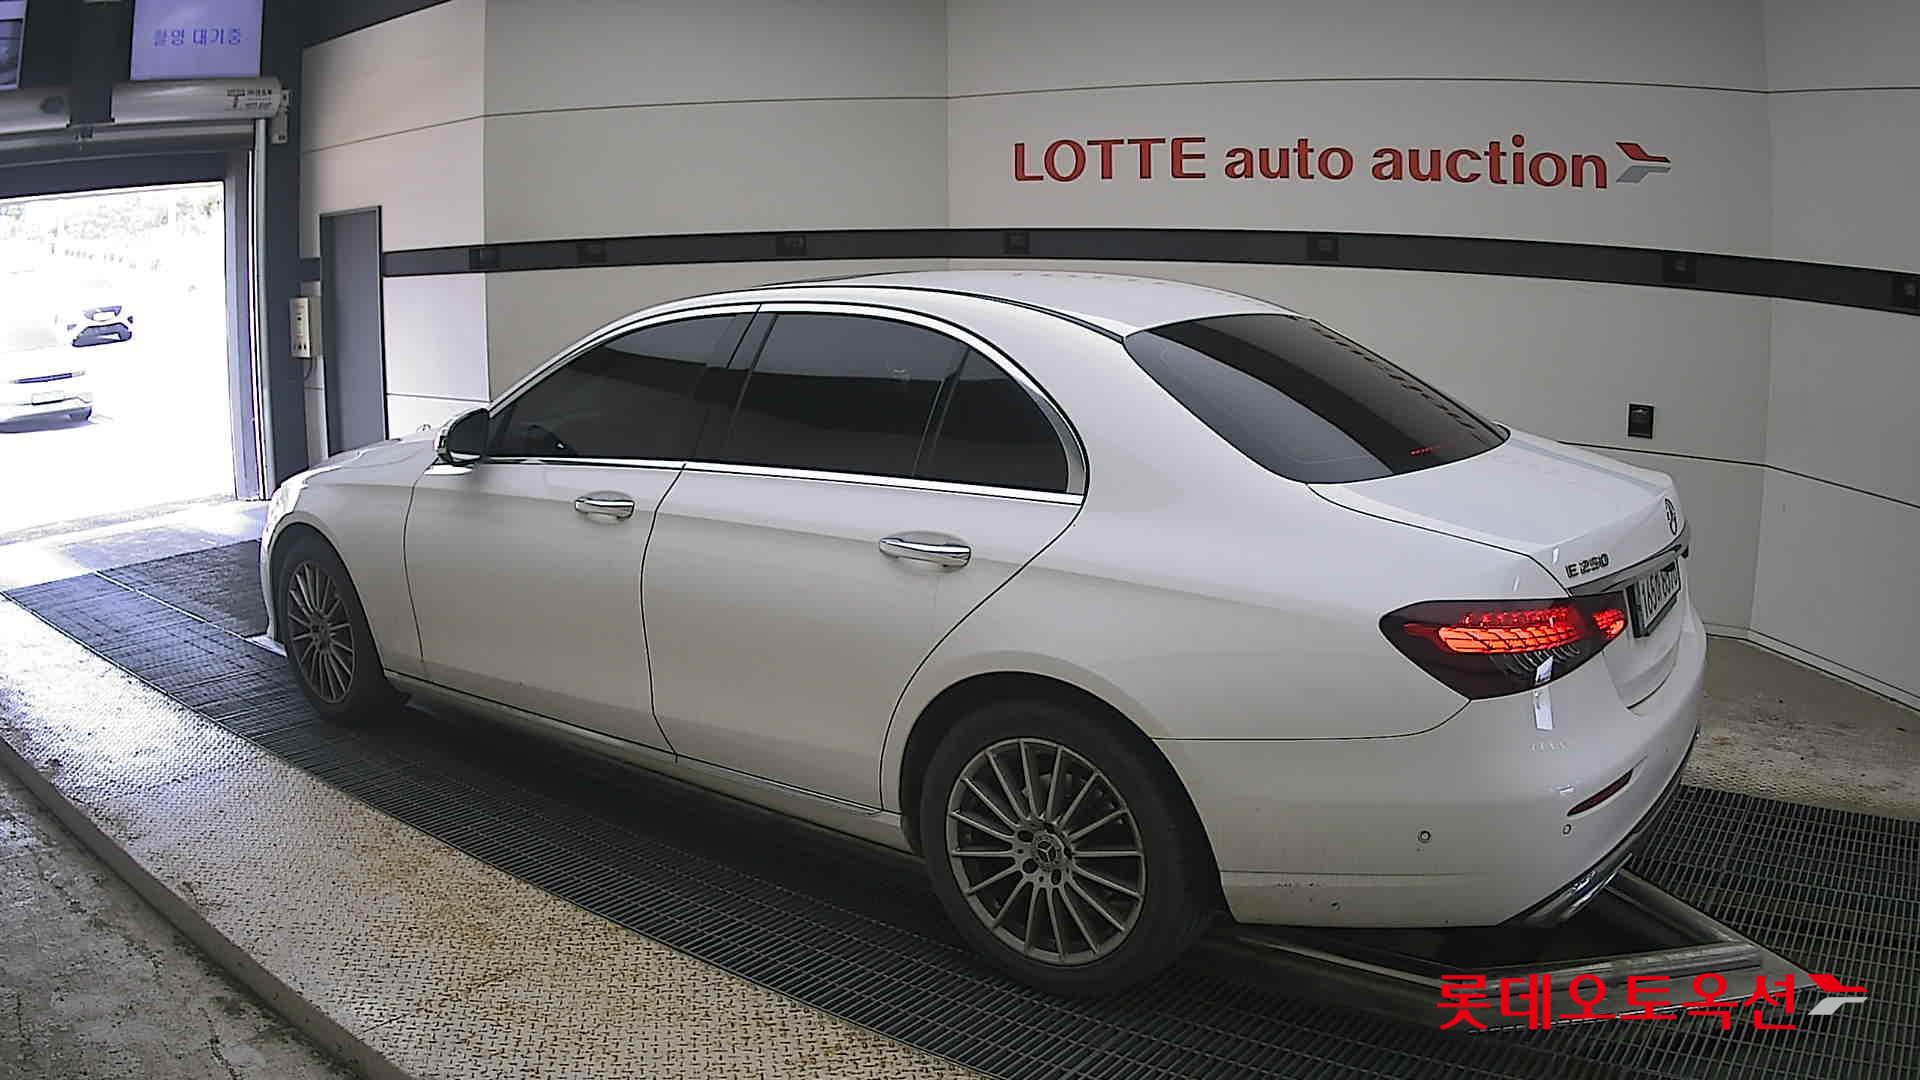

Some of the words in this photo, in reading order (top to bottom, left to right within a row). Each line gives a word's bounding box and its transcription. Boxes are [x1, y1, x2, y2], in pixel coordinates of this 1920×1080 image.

[192, 28, 242, 46] 대기중
[1015, 137, 1206, 182] LOTTE
[1224, 138, 1354, 180] auto
[1371, 134, 1608, 189] auction
[1566, 563, 1579, 578] E
